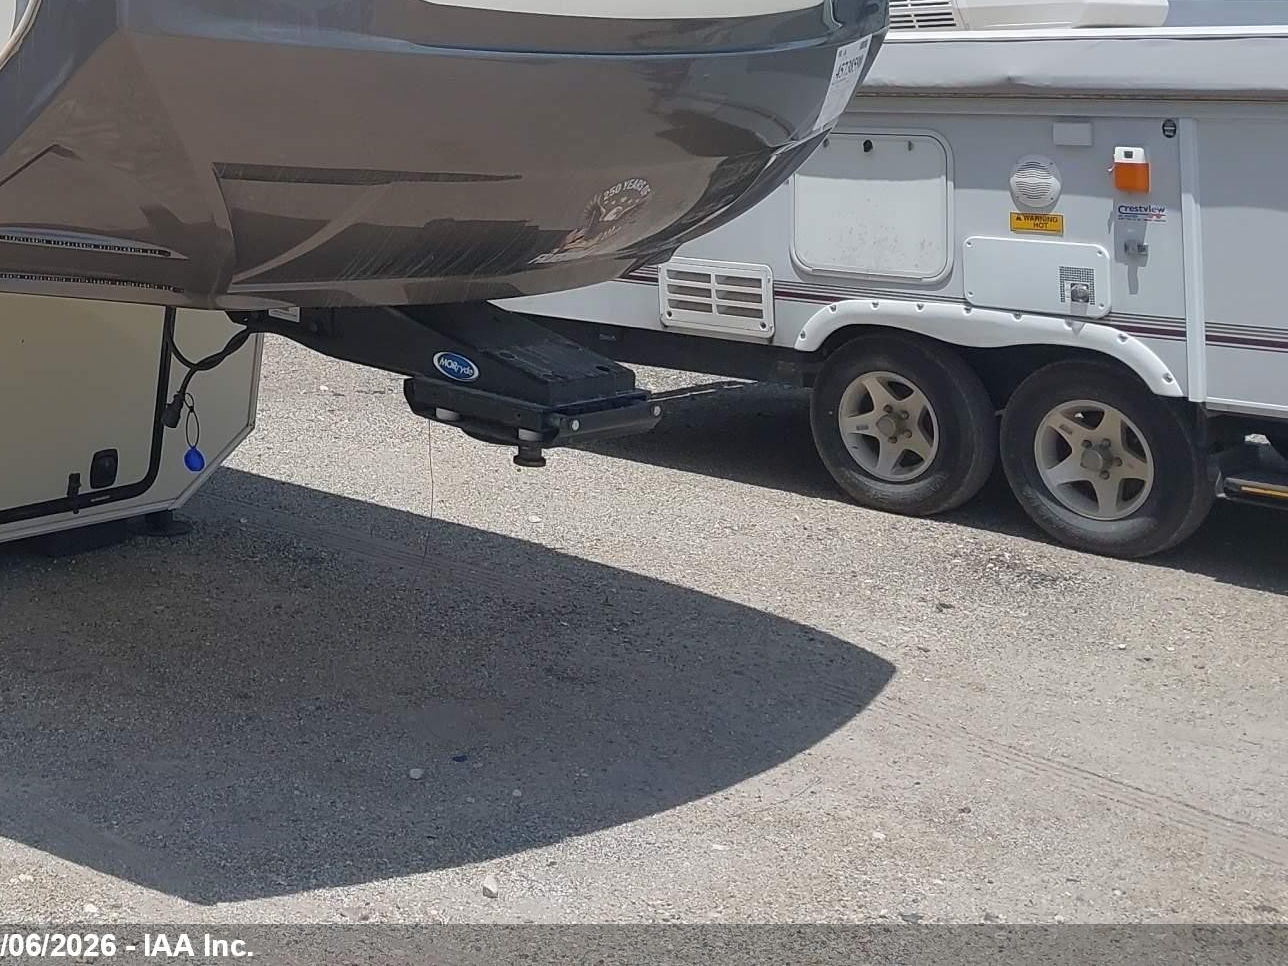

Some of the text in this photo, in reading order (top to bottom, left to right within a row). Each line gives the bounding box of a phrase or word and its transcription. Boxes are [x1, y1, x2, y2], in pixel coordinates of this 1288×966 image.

[622, 177, 647, 192] YEARS
[1117, 204, 1167, 216] Crestview
[1023, 214, 1059, 224] WARNING
